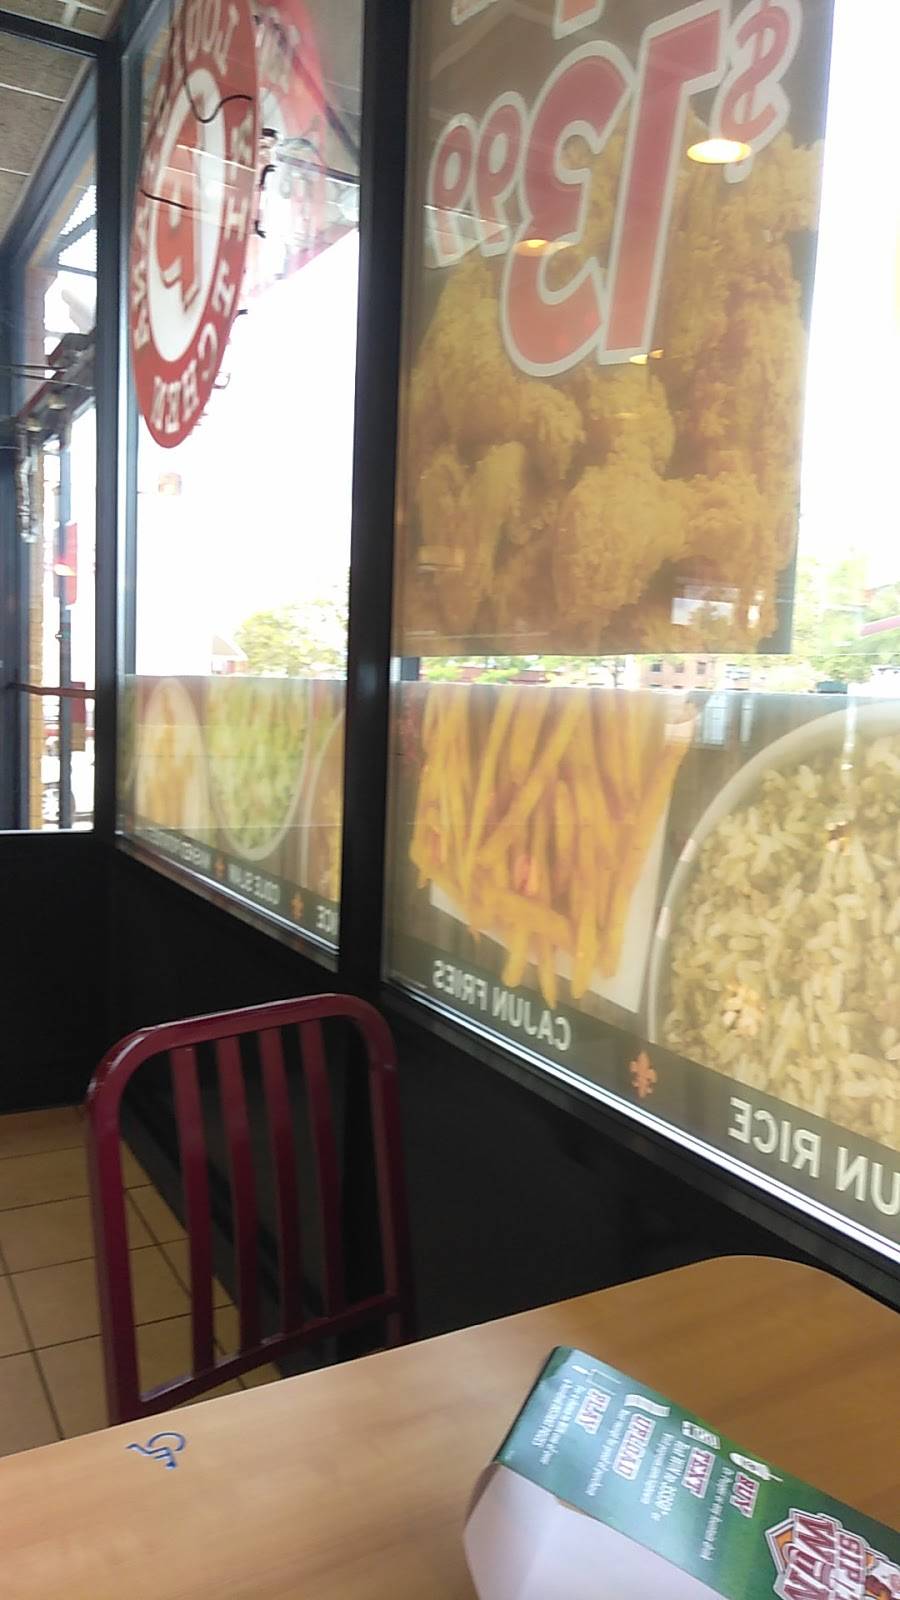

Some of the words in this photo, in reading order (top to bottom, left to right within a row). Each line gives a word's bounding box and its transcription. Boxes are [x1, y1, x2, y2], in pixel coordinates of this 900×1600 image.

[577, 1390, 609, 1433] PLAY
[615, 1414, 654, 1479] UPLOAD
[683, 1449, 714, 1497] TEXT
[731, 1472, 759, 1517] BUY
